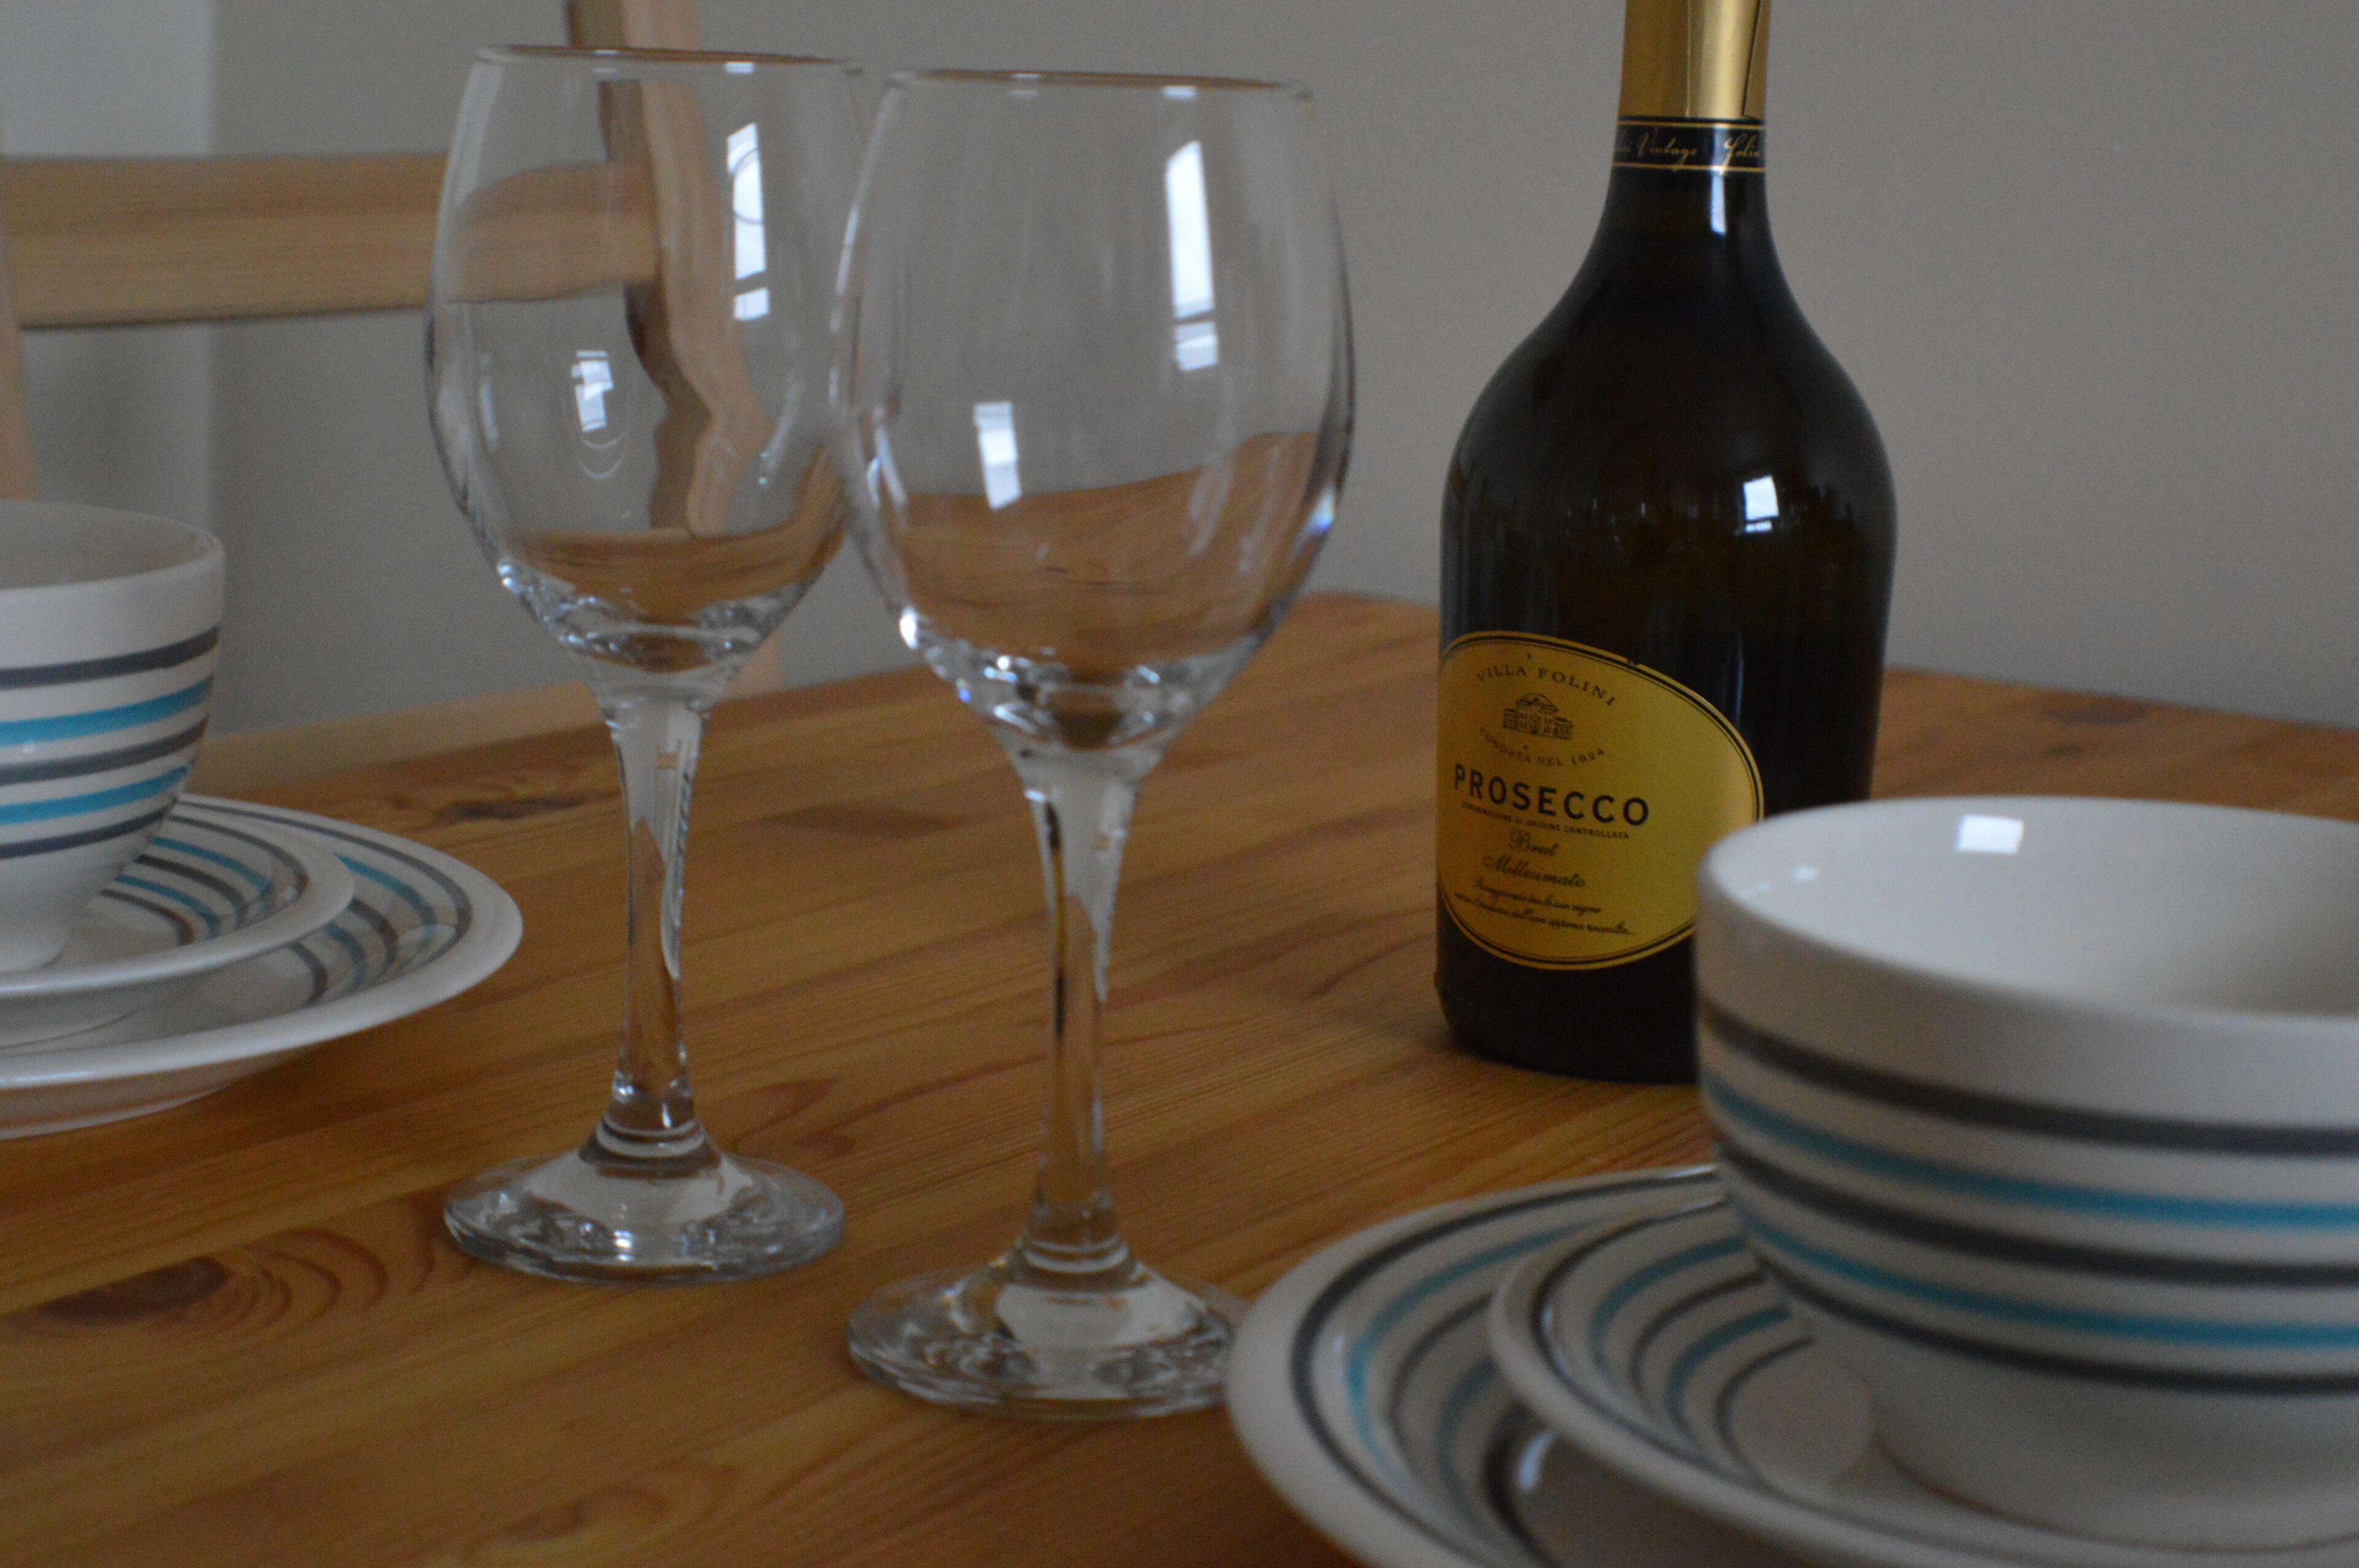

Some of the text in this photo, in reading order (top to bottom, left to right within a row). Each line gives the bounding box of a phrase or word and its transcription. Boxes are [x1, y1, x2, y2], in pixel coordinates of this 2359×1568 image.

[1476, 665, 1617, 706] VILLA FOLINI
[1538, 755, 1564, 766] NEL
[1454, 763, 1649, 826] PROSECCO
[1509, 829, 1560, 856] Brut
[1563, 825, 1630, 839] CONTROLLATA
[1482, 854, 1586, 888] Millesimato
